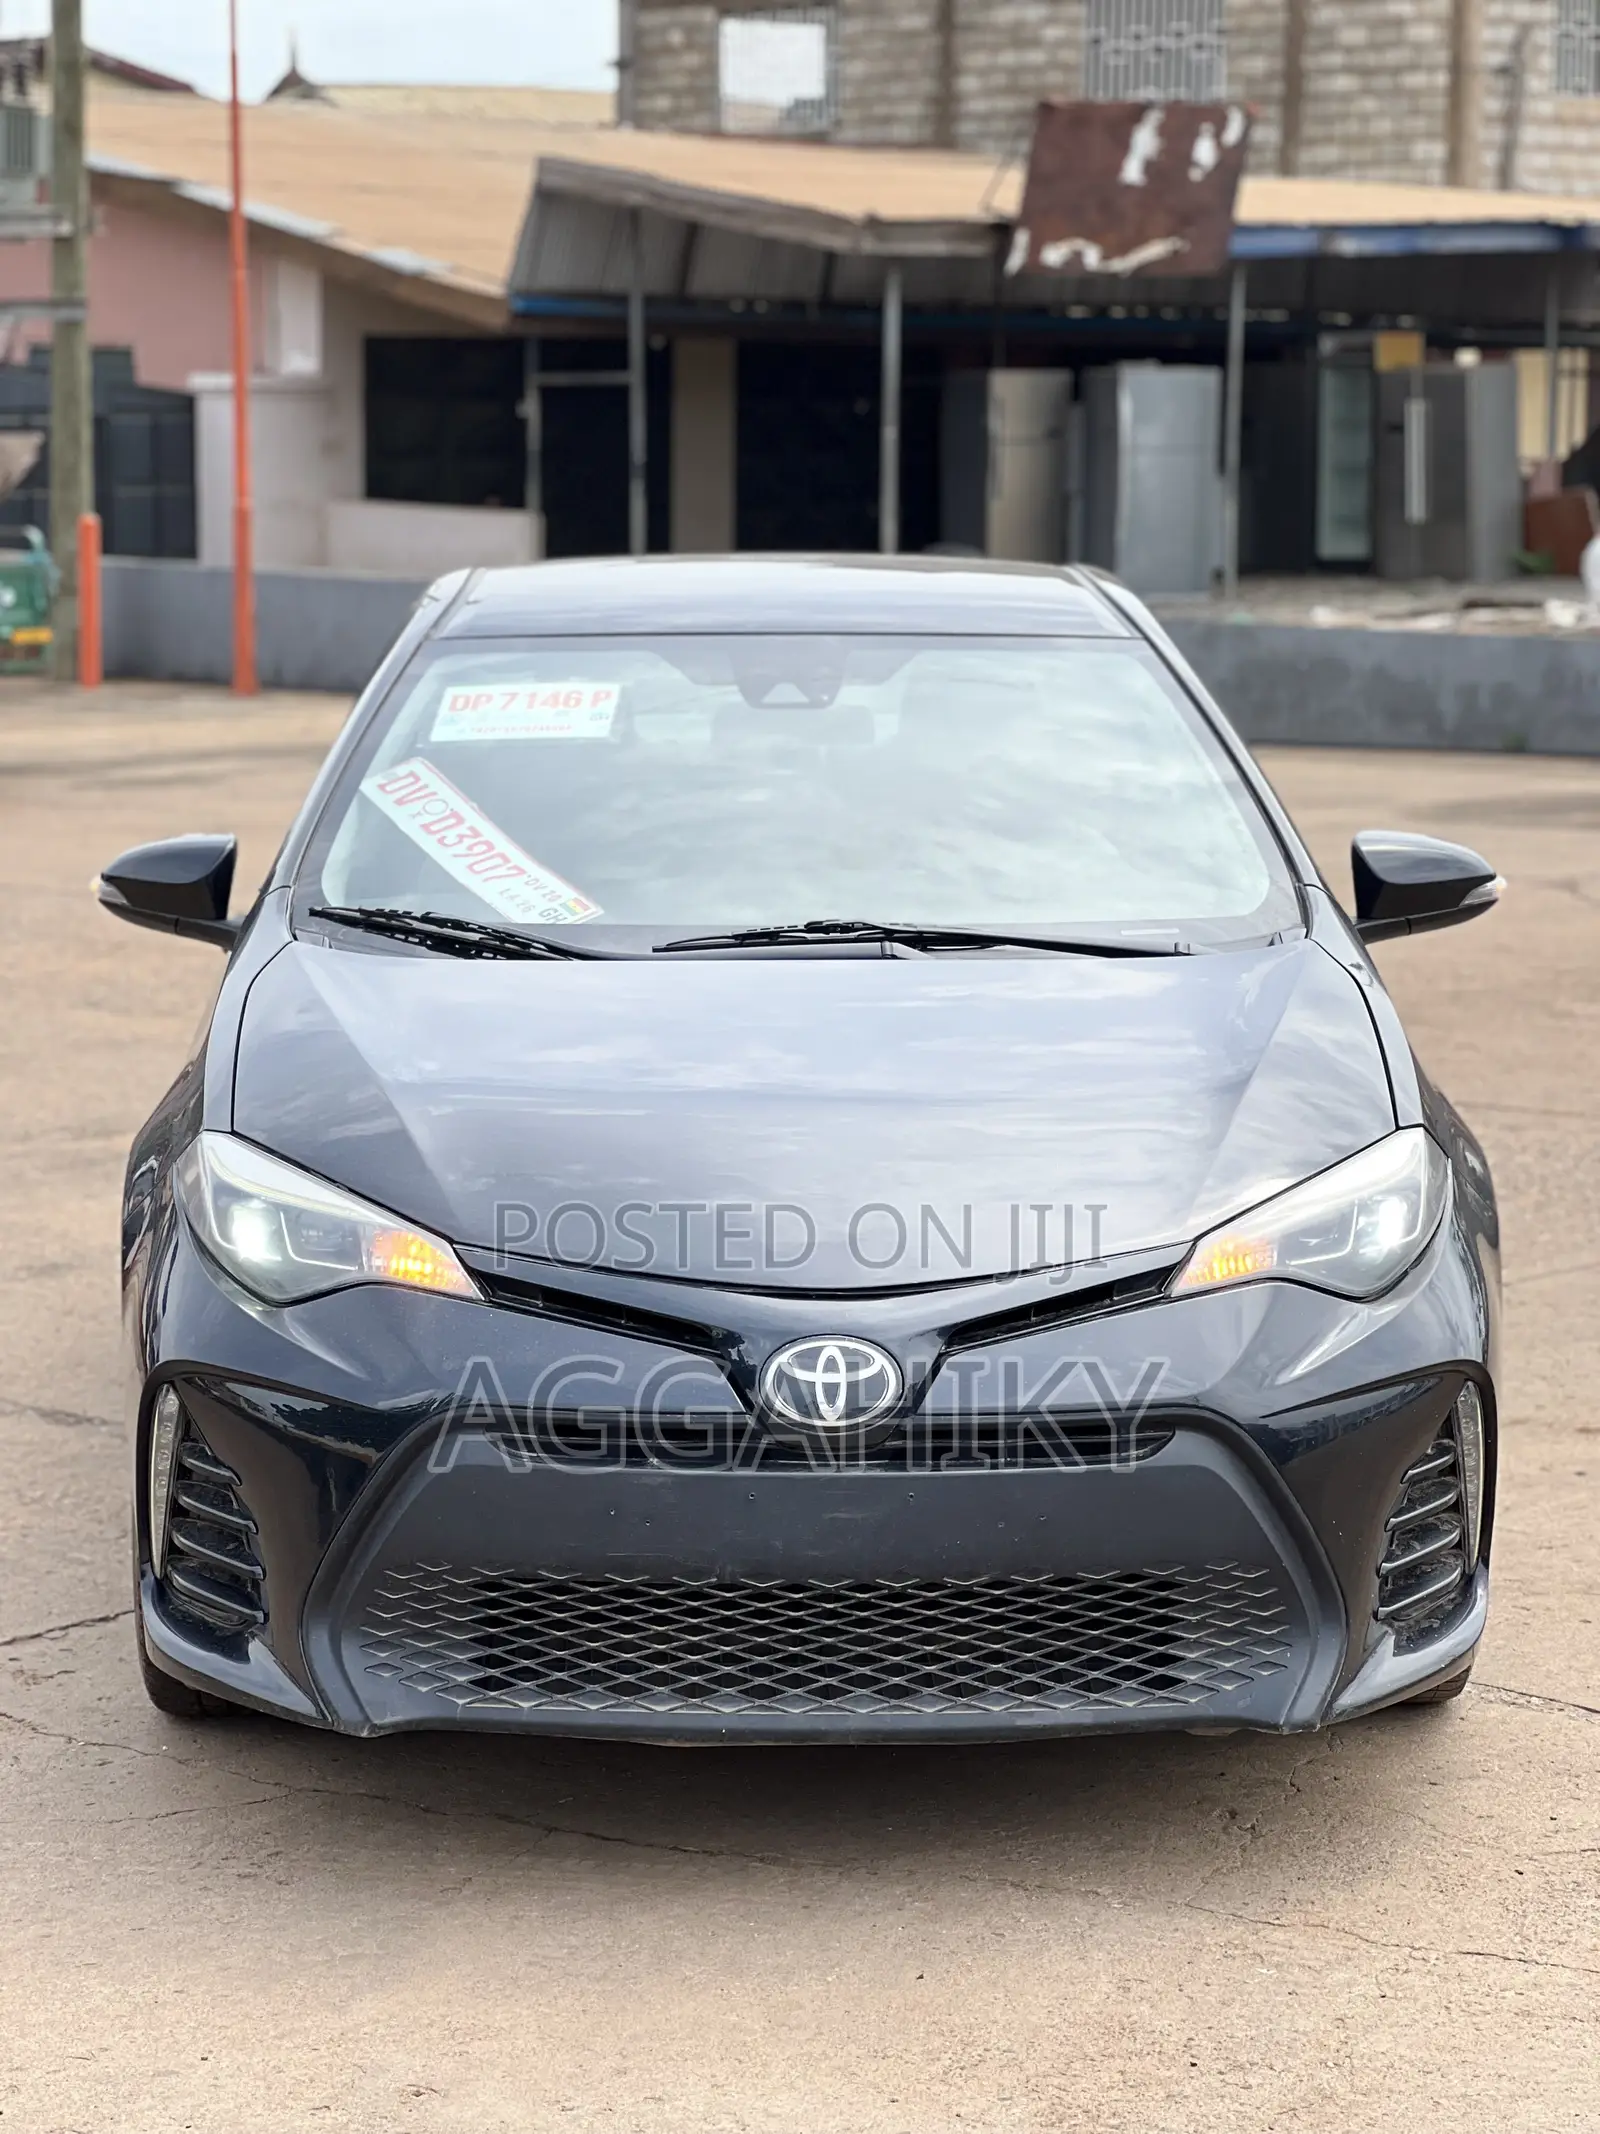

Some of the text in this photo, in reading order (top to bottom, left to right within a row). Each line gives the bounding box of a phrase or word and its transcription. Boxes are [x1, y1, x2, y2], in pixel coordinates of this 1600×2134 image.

[449, 690, 613, 712] DP 7146 P
[377, 771, 527, 882] DV D3907
[538, 907, 568, 922] GH
